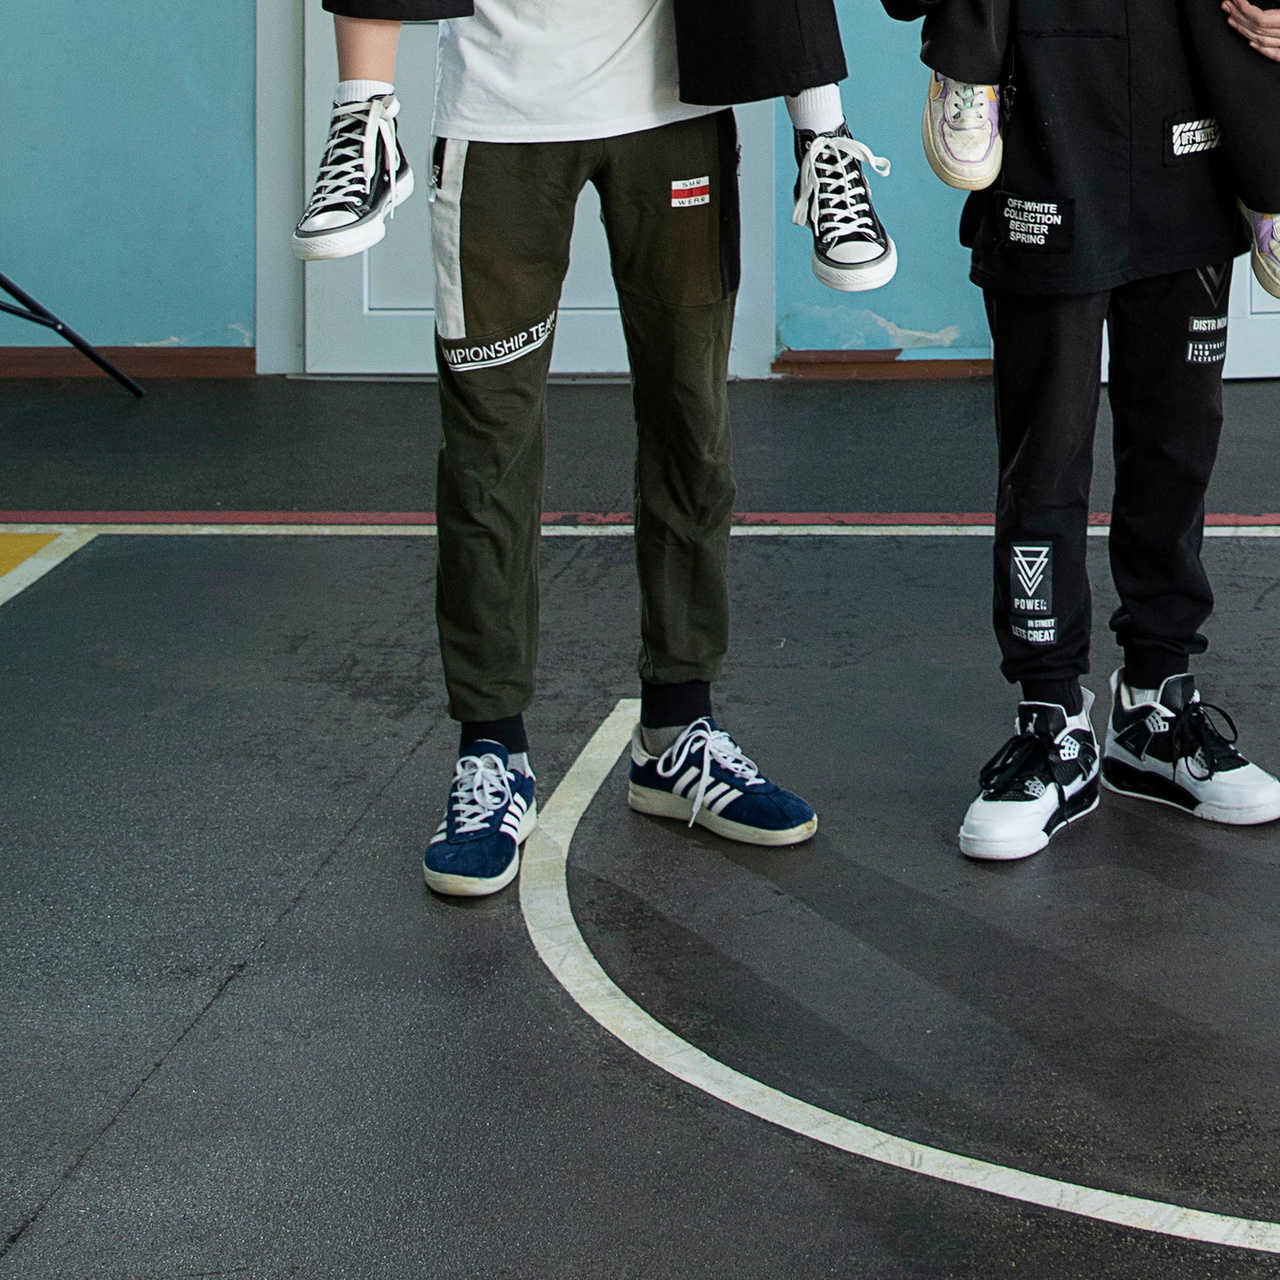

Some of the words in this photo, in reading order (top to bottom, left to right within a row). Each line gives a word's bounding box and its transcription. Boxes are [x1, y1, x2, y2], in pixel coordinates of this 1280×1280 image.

[1007, 197, 1058, 214] OFF-WHITE
[1003, 207, 1063, 225] COLLECTION
[1009, 219, 1049, 235] BESITER
[1009, 230, 1046, 245] SPRING
[1192, 319, 1217, 331] DISTR
[1014, 598, 1047, 610] POWER
[1027, 619, 1034, 627] IN
[1034, 618, 1055, 628] STREET
[1011, 624, 1027, 640] LETS
[1027, 628, 1055, 642] CREAT
